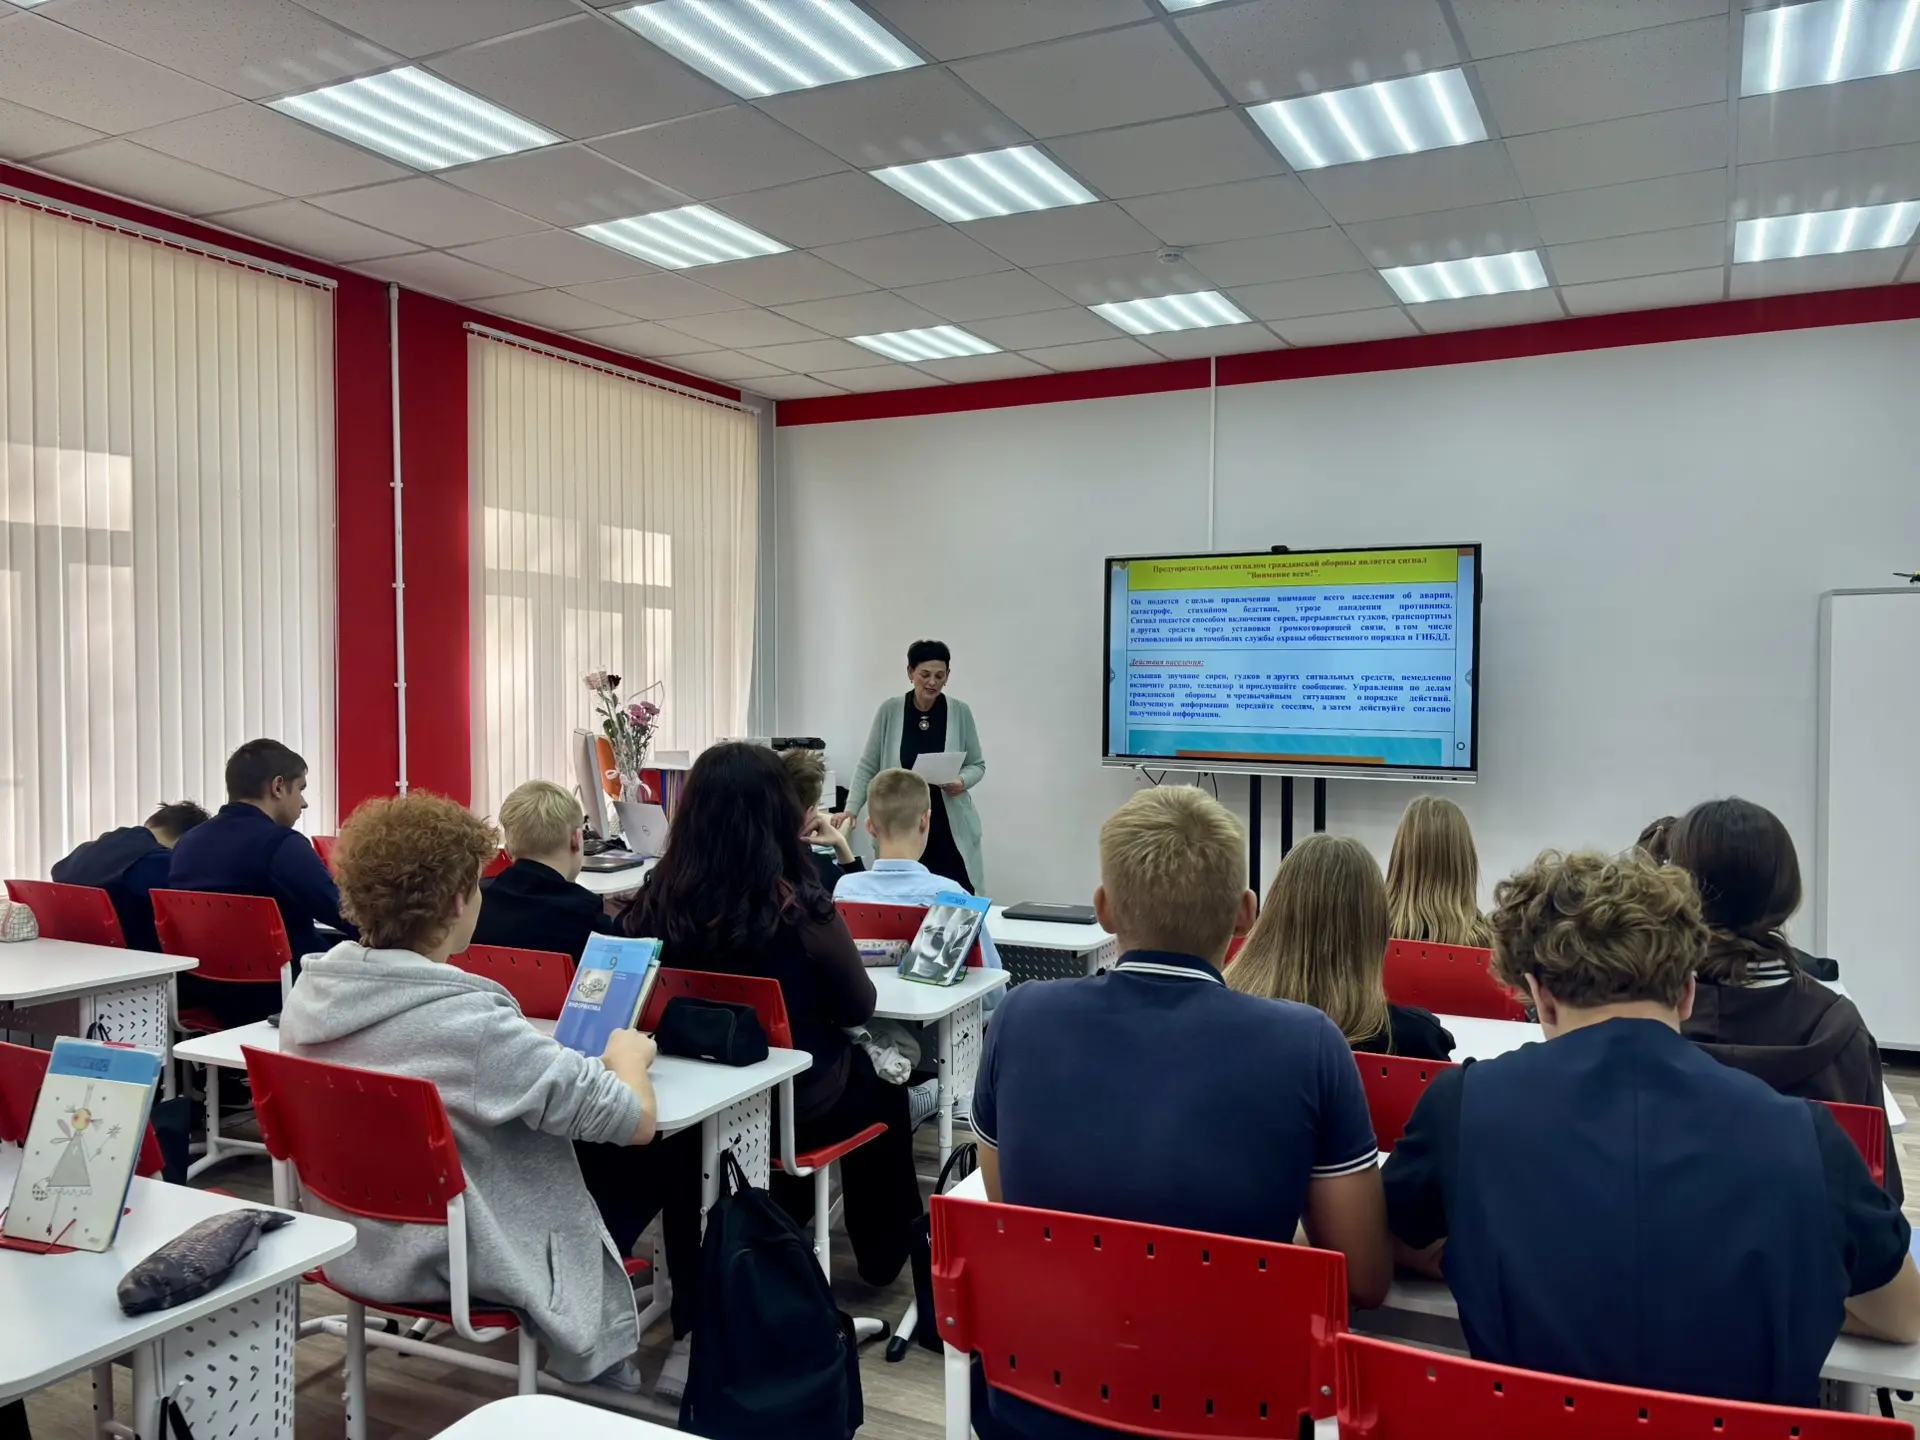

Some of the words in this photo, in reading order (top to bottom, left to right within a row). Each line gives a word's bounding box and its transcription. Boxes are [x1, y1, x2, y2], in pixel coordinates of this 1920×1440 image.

[1268, 560, 1320, 569] гражданской
[1321, 559, 1356, 568] обороны
[1221, 596, 1270, 605] привлечения
[1296, 604, 1322, 613] угрозе
[1192, 616, 1226, 624] способом
[1300, 614, 1356, 622] прерывистых
[1392, 613, 1452, 622] транспортных
[1168, 627, 1196, 635] средств
[1279, 624, 1352, 634] громкоговорящей
[1130, 636, 1182, 645] установленной
[1194, 634, 1242, 642] автомобилях
[1244, 635, 1274, 644] службы
[1276, 635, 1306, 644] охраны
[1308, 634, 1369, 642] общественного
[1371, 634, 1406, 643] порядка
[1246, 684, 1296, 692] прослушайте
[1353, 684, 1404, 692] Управления
[1184, 692, 1216, 700] обороны
[1234, 692, 1292, 700] чрезвычайным
[1364, 694, 1398, 702] порядке
[1180, 702, 1230, 710] информацию
[1236, 702, 1274, 710] передайте
[1359, 704, 1406, 712] действуйте
[609, 955, 618, 970] 9
